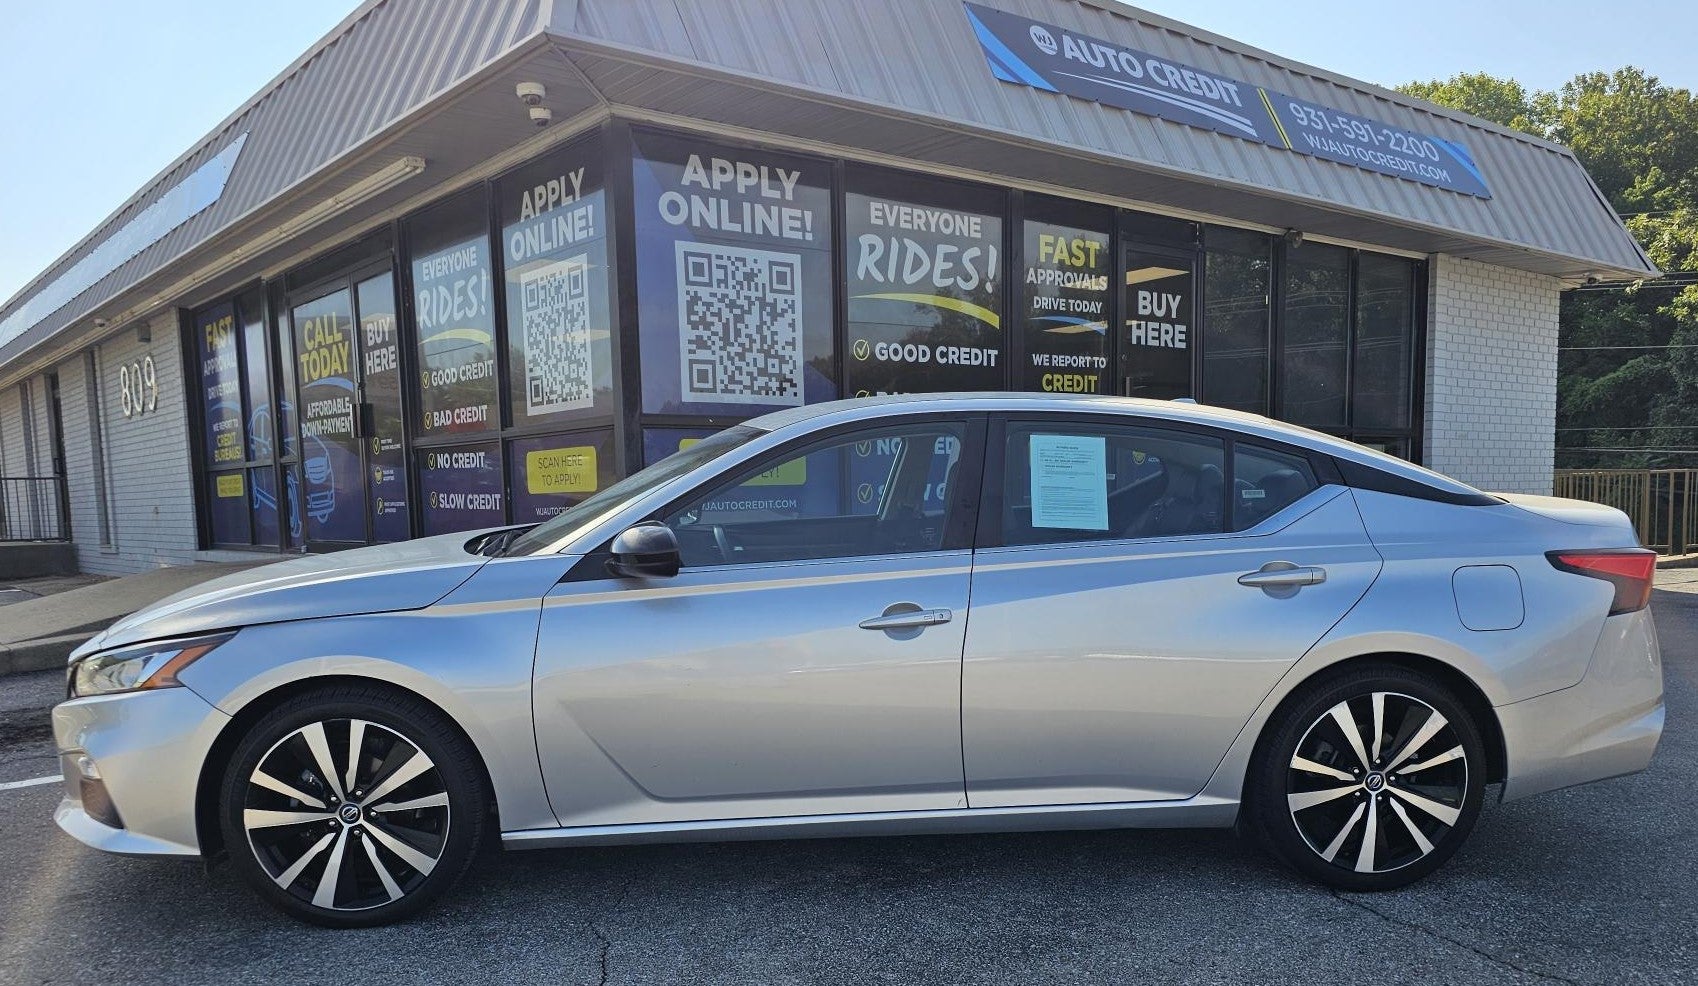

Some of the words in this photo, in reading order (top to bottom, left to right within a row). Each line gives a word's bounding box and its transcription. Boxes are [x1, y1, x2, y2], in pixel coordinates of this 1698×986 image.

[1063, 34, 1143, 79] AUTO
[1145, 59, 1242, 107] CREDIT
[1290, 102, 1440, 163] 931-591-2200
[1302, 131, 1452, 184] WJAUTOCREDIT.COM
[681, 154, 801, 200] APPLY
[520, 167, 585, 223] APPLY
[658, 190, 813, 241] ONLINE!
[870, 202, 982, 238] EVERYONE
[510, 204, 595, 262] ONLINE!
[422, 246, 477, 281] EVERYONE
[856, 233, 998, 294] RIDES!
[1039, 234, 1100, 268] FAST
[1026, 267, 1108, 291] APPROVALS
[418, 267, 487, 329] RIDES!
[1033, 296, 1066, 311] DRIVE
[1069, 299, 1102, 314] TODAY
[1138, 290, 1181, 319] BUY
[205, 315, 232, 352] FAST
[304, 312, 343, 349] CALL
[367, 317, 391, 347] BUY
[1131, 320, 1187, 349] HERE
[301, 341, 350, 383] TODAY
[365, 346, 396, 375] HERE
[875, 342, 930, 363] GOOD
[936, 345, 999, 367] CREDIT
[1032, 354, 1049, 366] WE
[1052, 355, 1091, 368] REPORT
[1093, 356, 1106, 368] TO
[121, 356, 157, 416] 809
[431, 369, 457, 388] GOOD
[459, 359, 494, 381] CREDIT
[1042, 374, 1098, 392] CREDIT
[307, 396, 351, 419] AFFORDABLE
[433, 409, 451, 427] BAD
[453, 404, 488, 424] CREDIT
[301, 416, 351, 438] DOWN-PAYMEN
[436, 454, 451, 469] NO
[453, 451, 485, 469] CREDIT
[538, 457, 559, 469] SCAN
[562, 454, 583, 467] HERE
[541, 475, 552, 486] TO
[554, 473, 581, 486] APPLY!
[439, 493, 468, 510] SLOW
[470, 493, 501, 511] CREDIT
